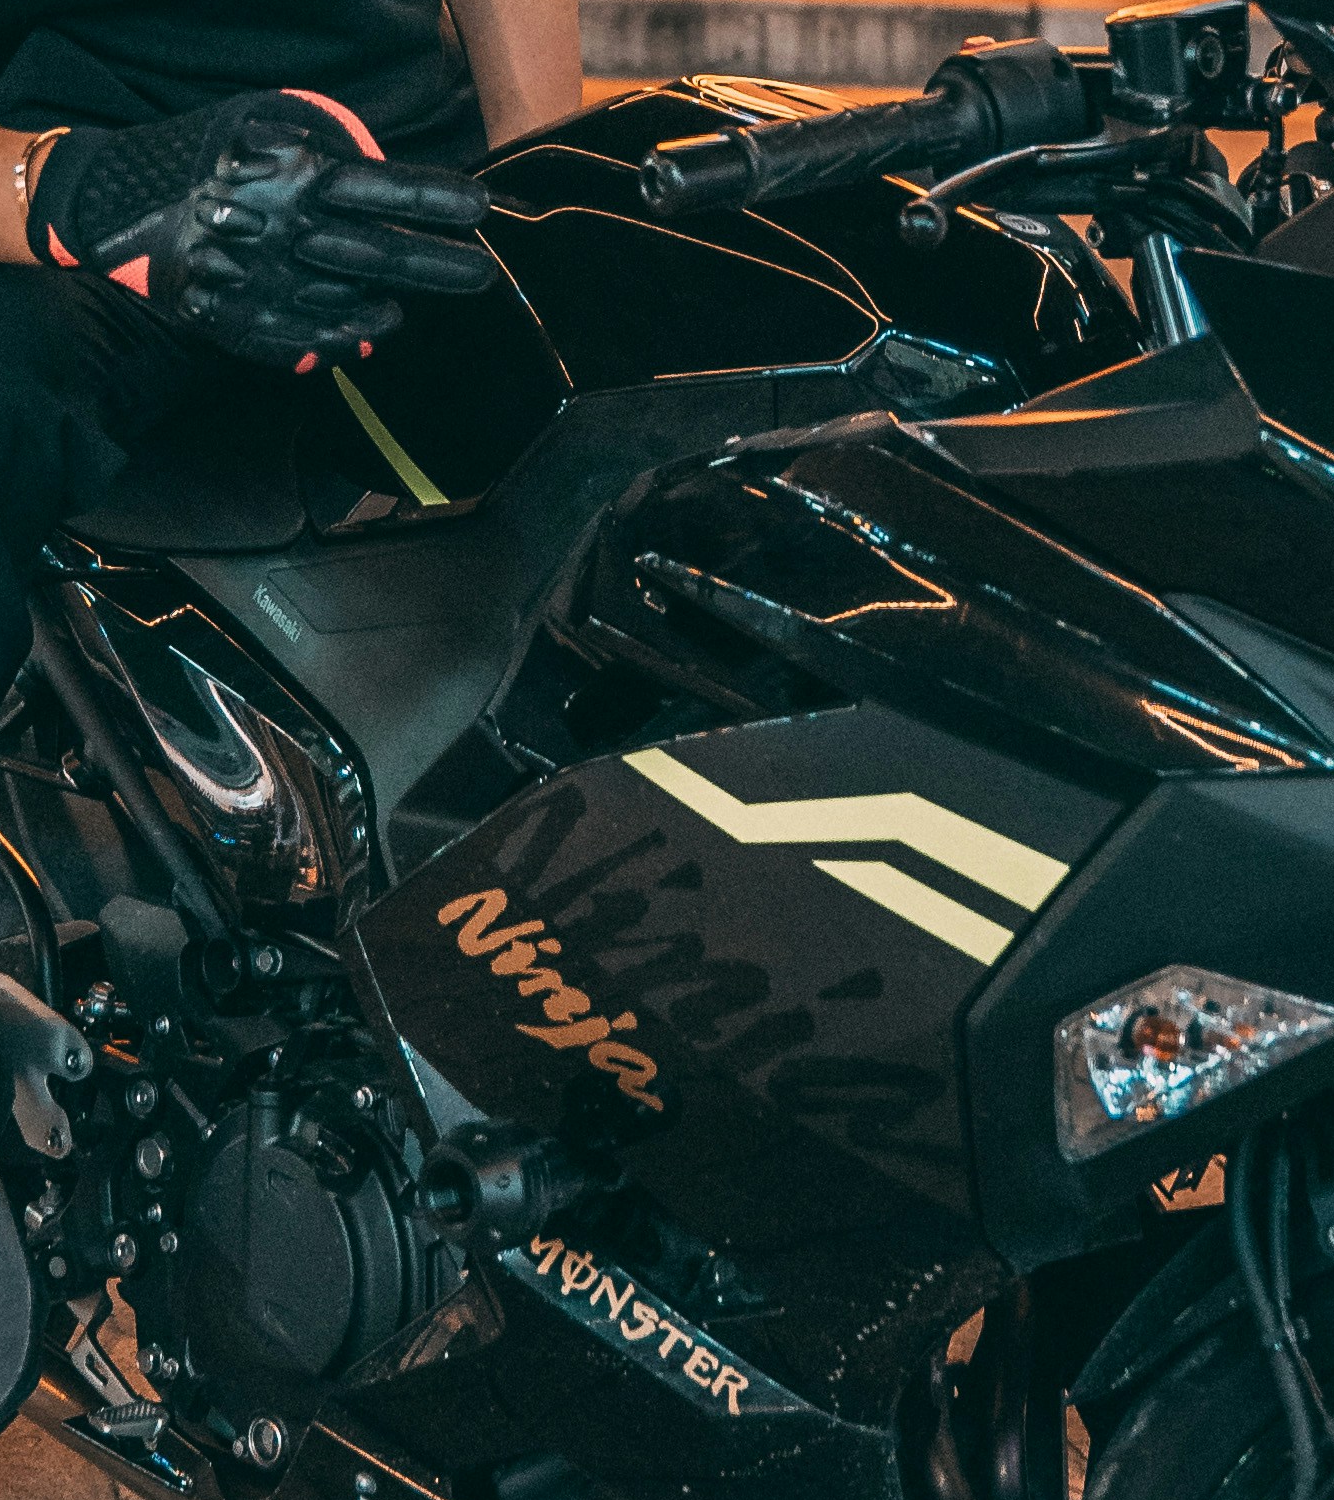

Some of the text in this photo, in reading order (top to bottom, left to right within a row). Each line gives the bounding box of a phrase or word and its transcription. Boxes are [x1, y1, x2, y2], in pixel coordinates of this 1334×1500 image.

[252, 584, 302, 643] Kawasaki
[437, 888, 664, 1112] Ninja
[530, 1234, 749, 1416] MONSTER
